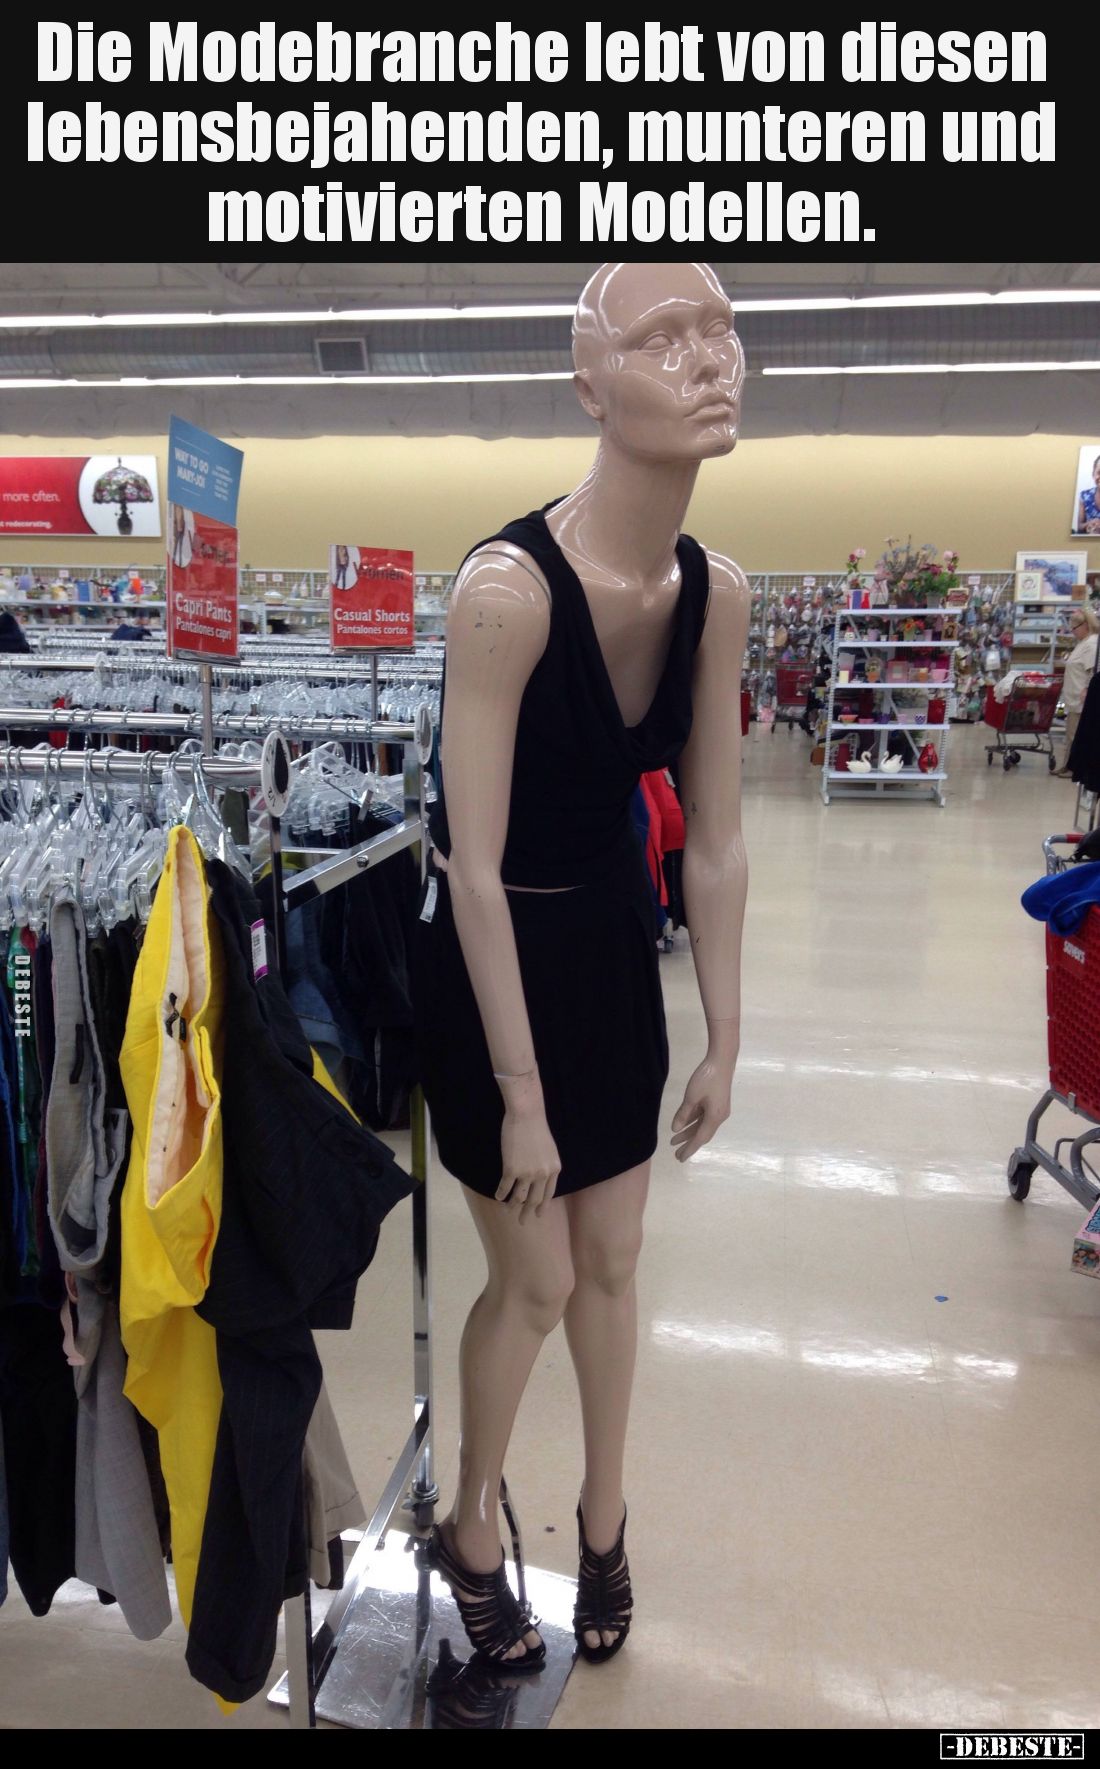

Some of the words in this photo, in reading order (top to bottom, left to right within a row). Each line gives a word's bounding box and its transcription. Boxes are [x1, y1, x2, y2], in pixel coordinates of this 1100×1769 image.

[174, 447, 190, 465] WAY
[190, 454, 198, 469] TO
[199, 459, 209, 474] GO
[3, 492, 30, 502] more
[176, 592, 203, 619] Capri
[206, 600, 232, 623] Pants
[334, 608, 372, 621] Casual
[375, 609, 410, 622] Shorts
[176, 616, 215, 636] Pantalones
[216, 627, 232, 642] capri
[337, 624, 382, 634] Pantalones
[383, 625, 408, 635] cortos
